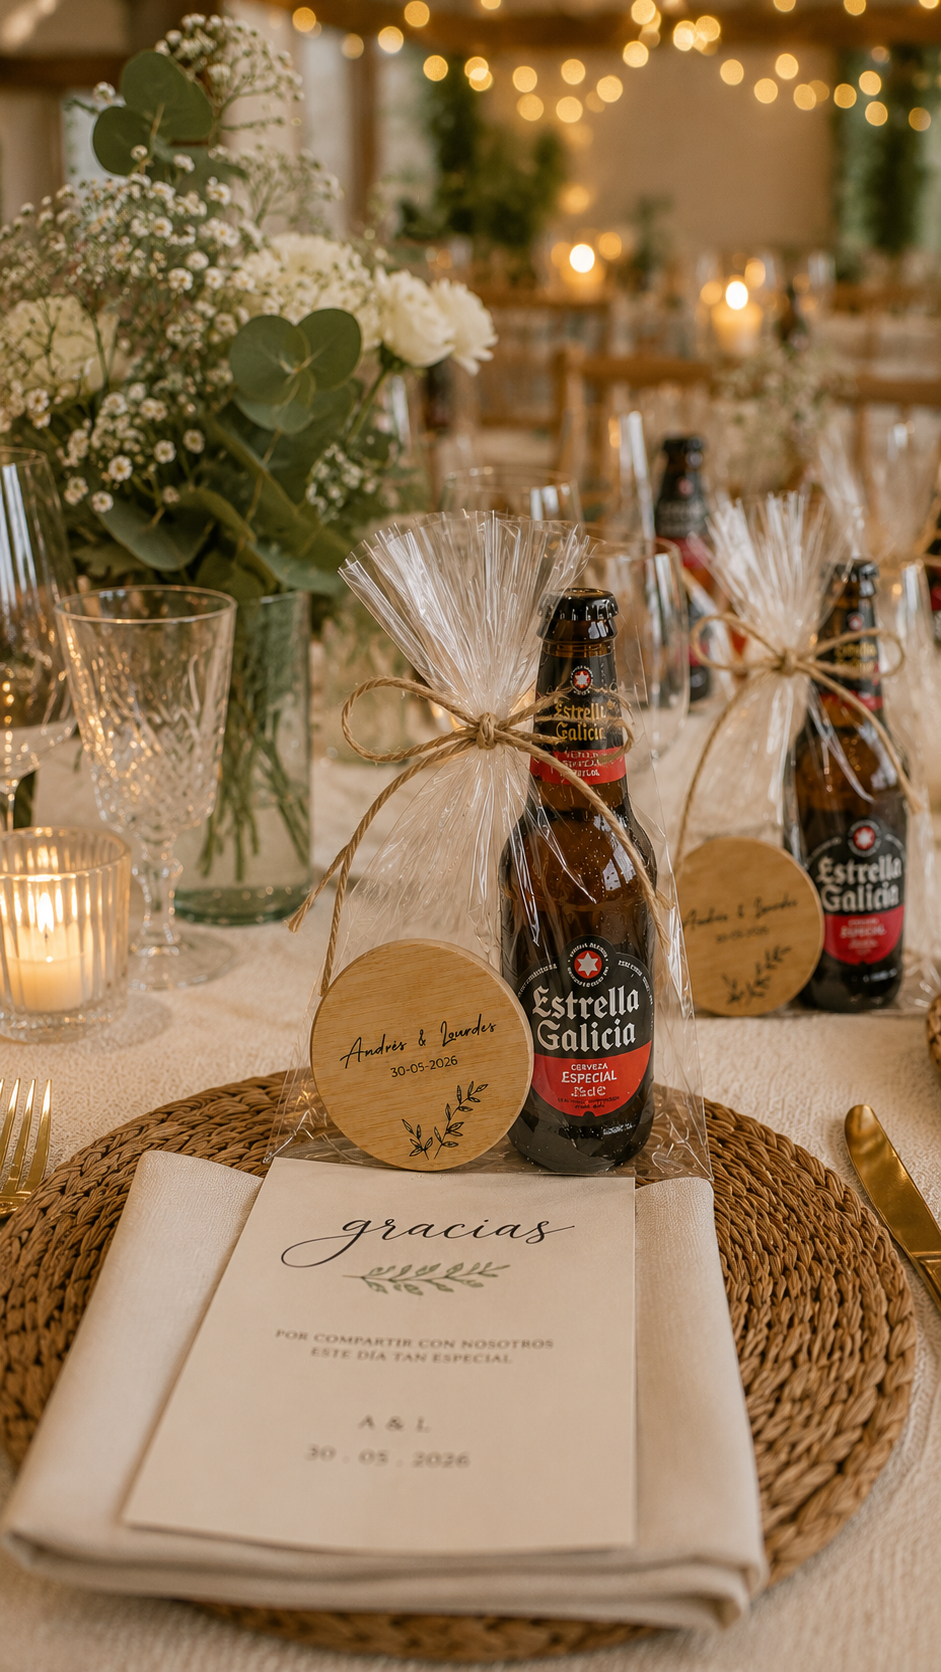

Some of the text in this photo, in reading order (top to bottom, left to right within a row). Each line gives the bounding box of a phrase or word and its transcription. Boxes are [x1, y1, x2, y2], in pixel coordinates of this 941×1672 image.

[816, 855, 903, 886] Estrella
[821, 882, 900, 913] Galicia
[532, 985, 639, 1020] Estrella
[418, 1029, 426, 1047] &
[440, 1013, 497, 1047] Lourdes
[537, 1018, 636, 1052] Galicia
[390, 1055, 458, 1078] 30-05-2026
[561, 1070, 617, 1084] ESPECIAL
[571, 1063, 608, 1071] CERVEZA
[281, 1218, 575, 1268] gracias
[276, 1329, 555, 1350] POR COMPARTIR CON NOSOTROS
[311, 1346, 350, 1359] ESTE
[394, 1352, 427, 1363] TAN
[433, 1353, 513, 1364] ESPECIAL
[357, 1414, 376, 1431] A
[385, 1416, 404, 1432] &
[305, 1443, 338, 1463] 30
[357, 1448, 389, 1467] 05
[411, 1450, 471, 1469] 2026
